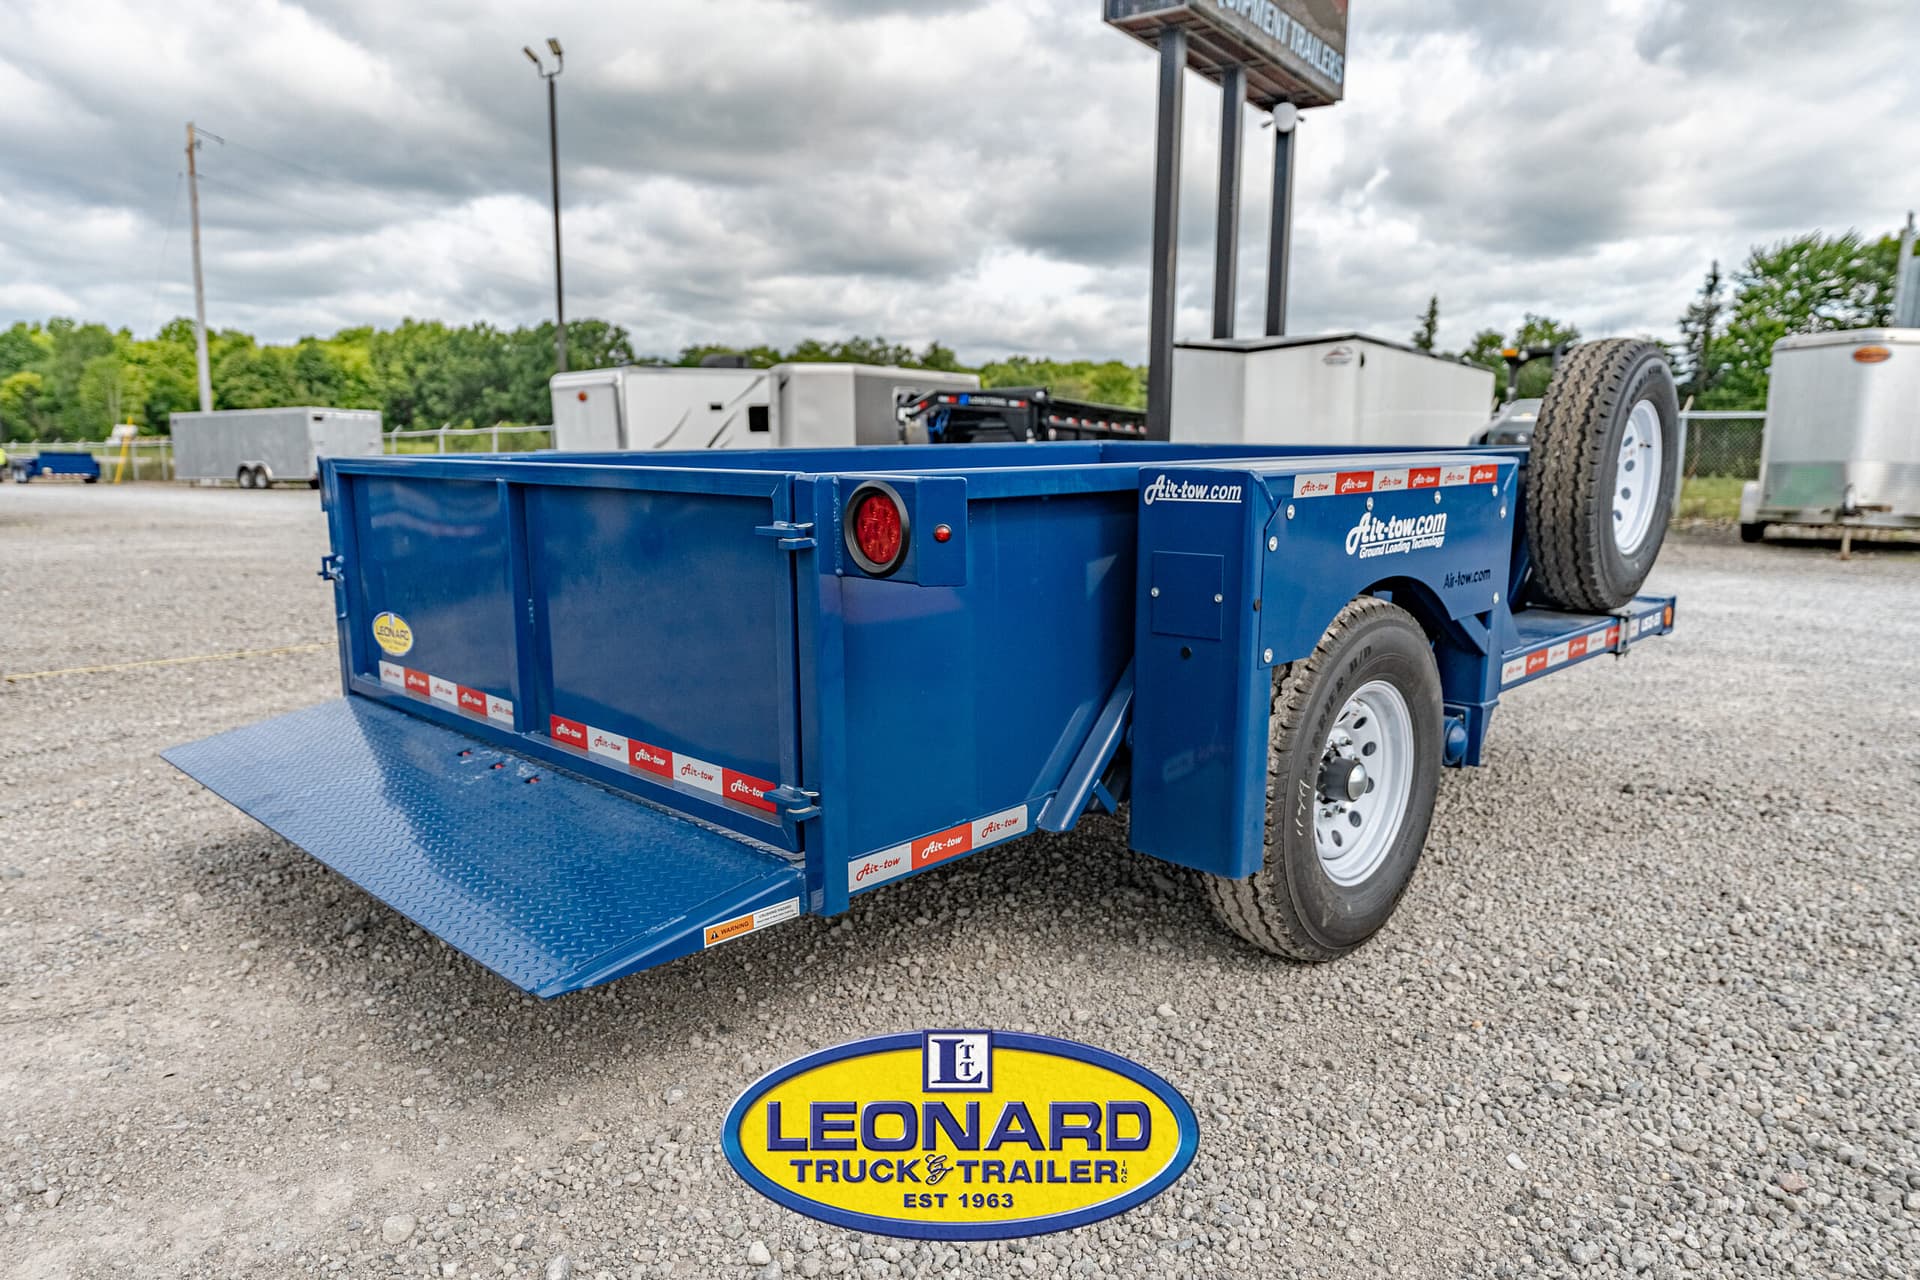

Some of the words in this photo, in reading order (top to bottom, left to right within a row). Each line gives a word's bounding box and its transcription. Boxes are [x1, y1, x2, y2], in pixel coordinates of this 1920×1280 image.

[1289, 19, 1343, 85] TRAILERS
[1144, 474, 1242, 505] Air-tow.com
[1301, 481, 1329, 495] Air-tow
[1341, 478, 1369, 492] Air-tow
[1345, 512, 1448, 555] Air-tow.com
[1359, 545, 1385, 559] Ground
[1385, 541, 1411, 554] Loading
[1411, 536, 1445, 549] Technology
[1443, 569, 1491, 589] Air-tow.com
[556, 723, 583, 740] Air-tow
[593, 736, 622, 752] Air-tow
[635, 749, 667, 767] Air-tow
[680, 763, 715, 783] Air-tow
[856, 858, 901, 882] Air-tow
[921, 835, 963, 860] Air-tow
[981, 815, 1019, 839] Air-tow
[720, 920, 750, 935] WARNING
